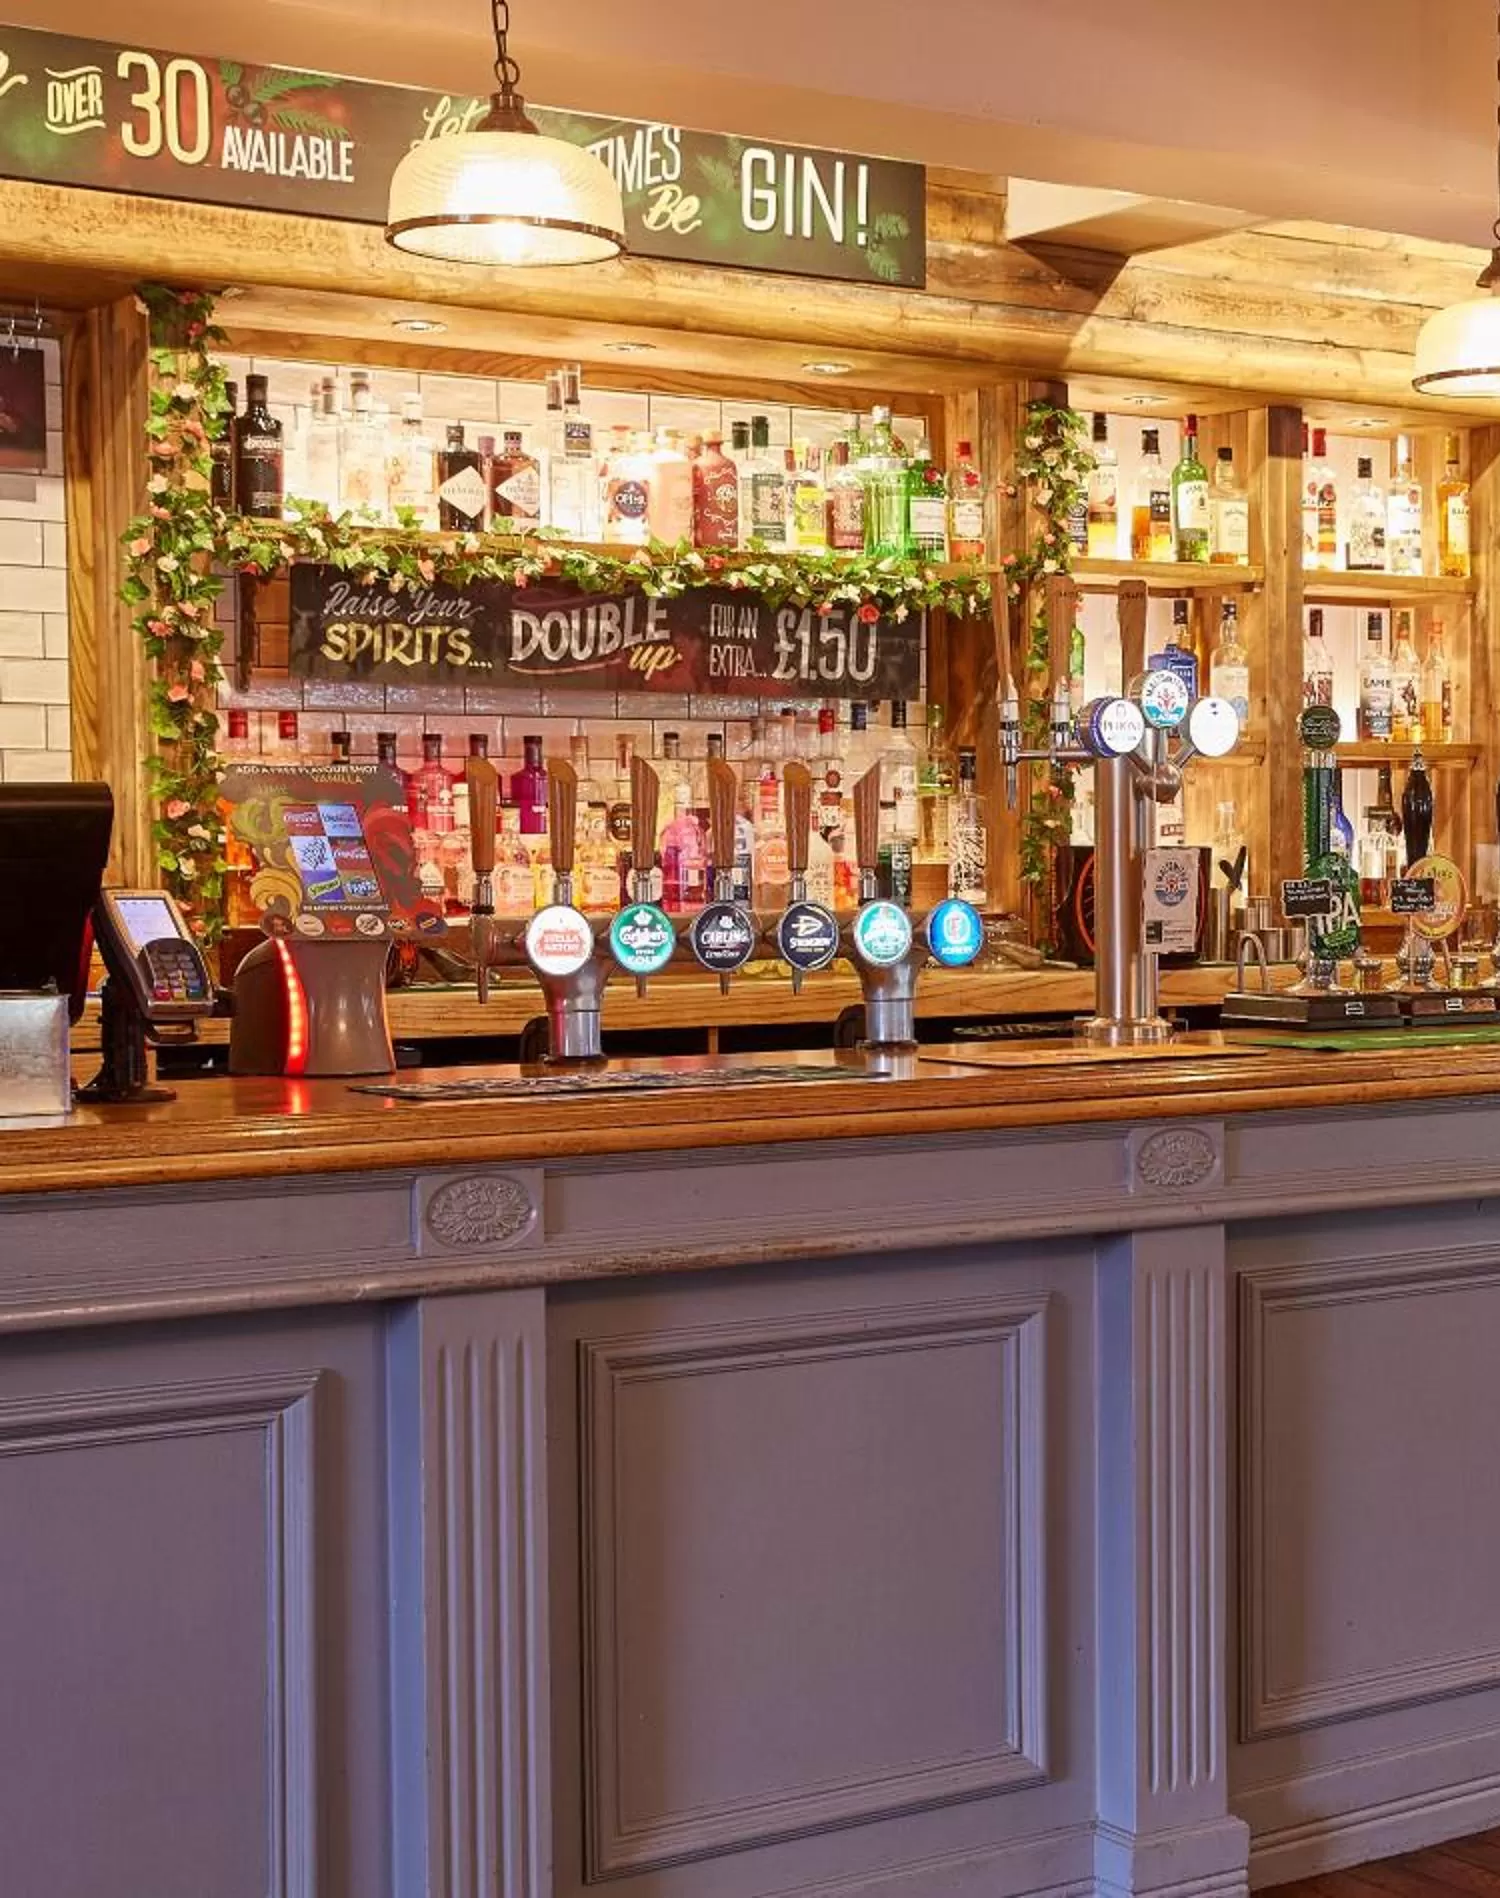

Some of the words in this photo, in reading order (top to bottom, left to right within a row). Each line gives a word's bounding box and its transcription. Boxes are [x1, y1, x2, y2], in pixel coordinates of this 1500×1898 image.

[46, 74, 104, 124] OVER
[116, 51, 211, 165] 30
[221, 125, 355, 183] AVAILABLE
[641, 184, 703, 235] Be
[741, 147, 870, 246] GIN!
[323, 581, 401, 617] Raise
[407, 590, 485, 625] Your
[507, 595, 671, 662] DOUBLE
[709, 603, 735, 638] FOR
[737, 607, 759, 640] AN
[771, 608, 878, 682] £1.50
[1316, 890, 1362, 936] IPA
